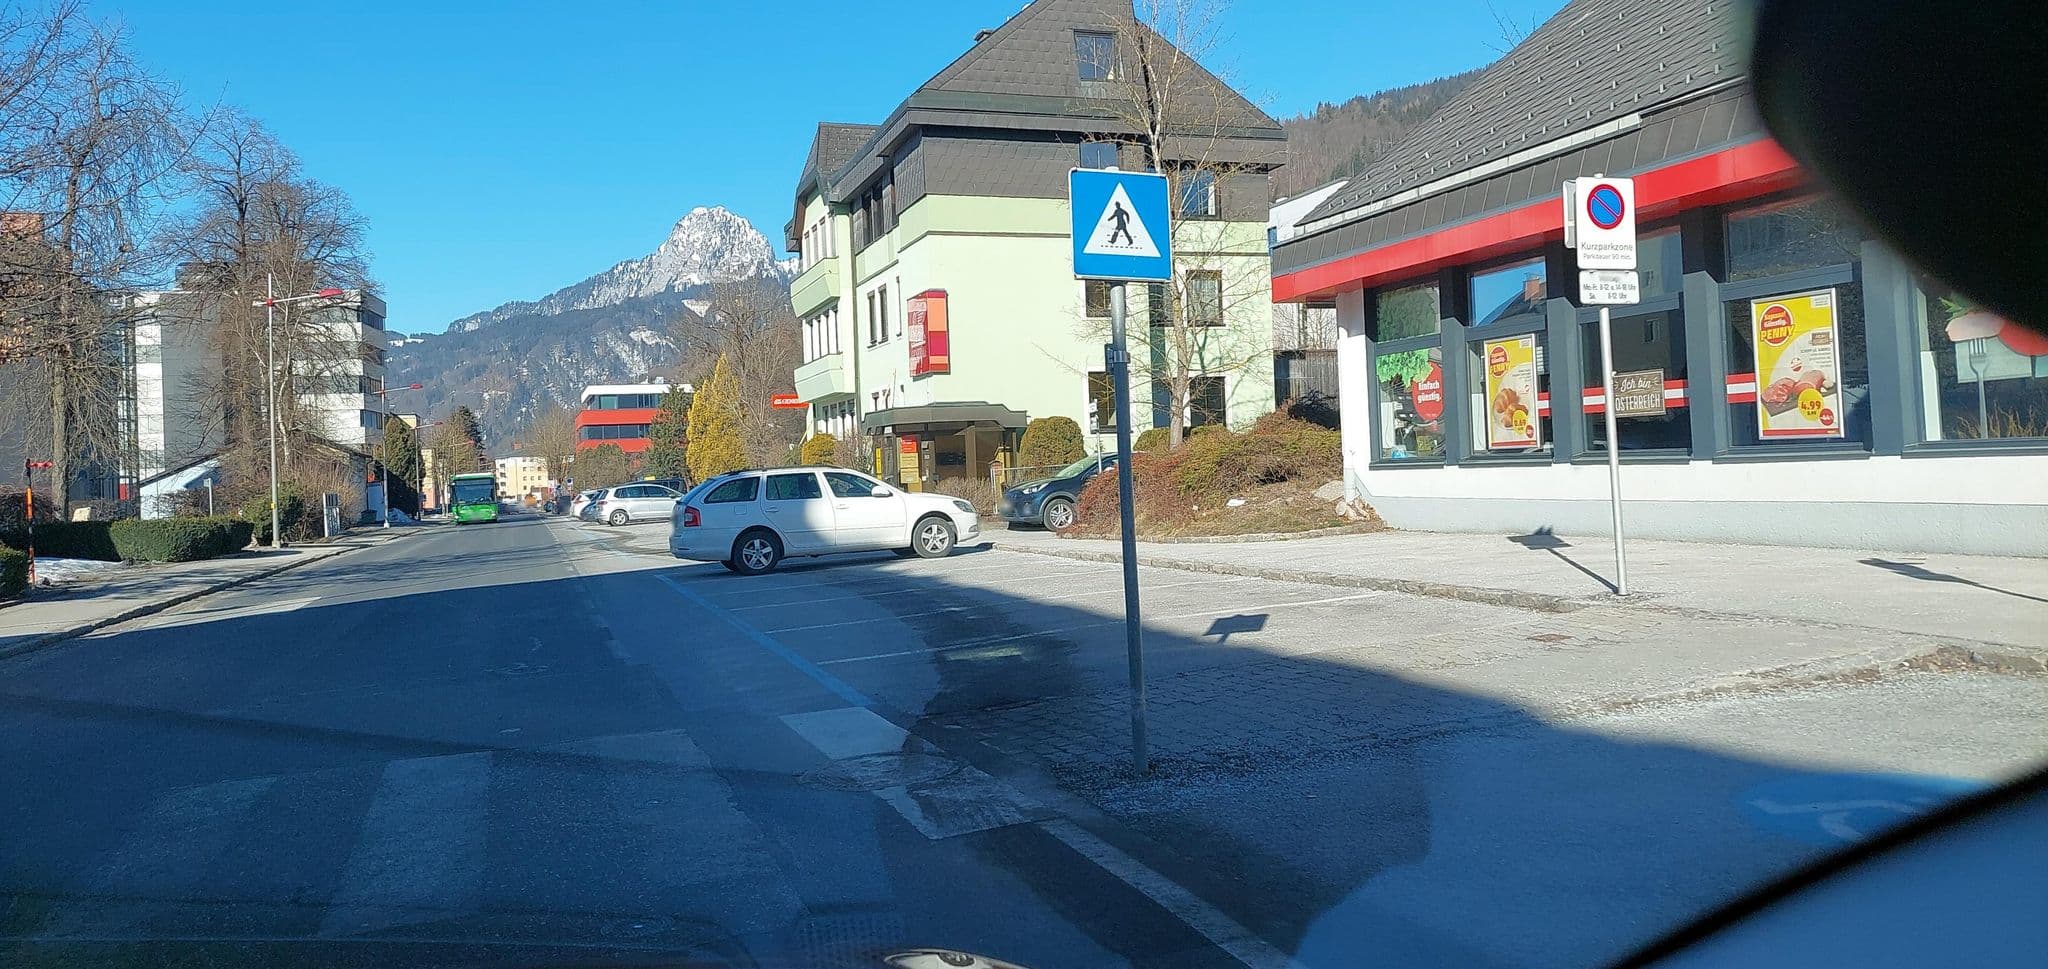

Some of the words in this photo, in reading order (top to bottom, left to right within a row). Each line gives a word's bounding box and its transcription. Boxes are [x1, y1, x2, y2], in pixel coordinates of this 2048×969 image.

[1581, 241, 1633, 252] Kurzparkzone
[1760, 325, 1796, 341] PENNY
[1418, 380, 1440, 391] Einfach
[1620, 377, 1636, 393] Ich
[1637, 377, 1652, 389] bin
[1417, 390, 1442, 404] günstig.
[1801, 400, 1821, 411] 4.99
